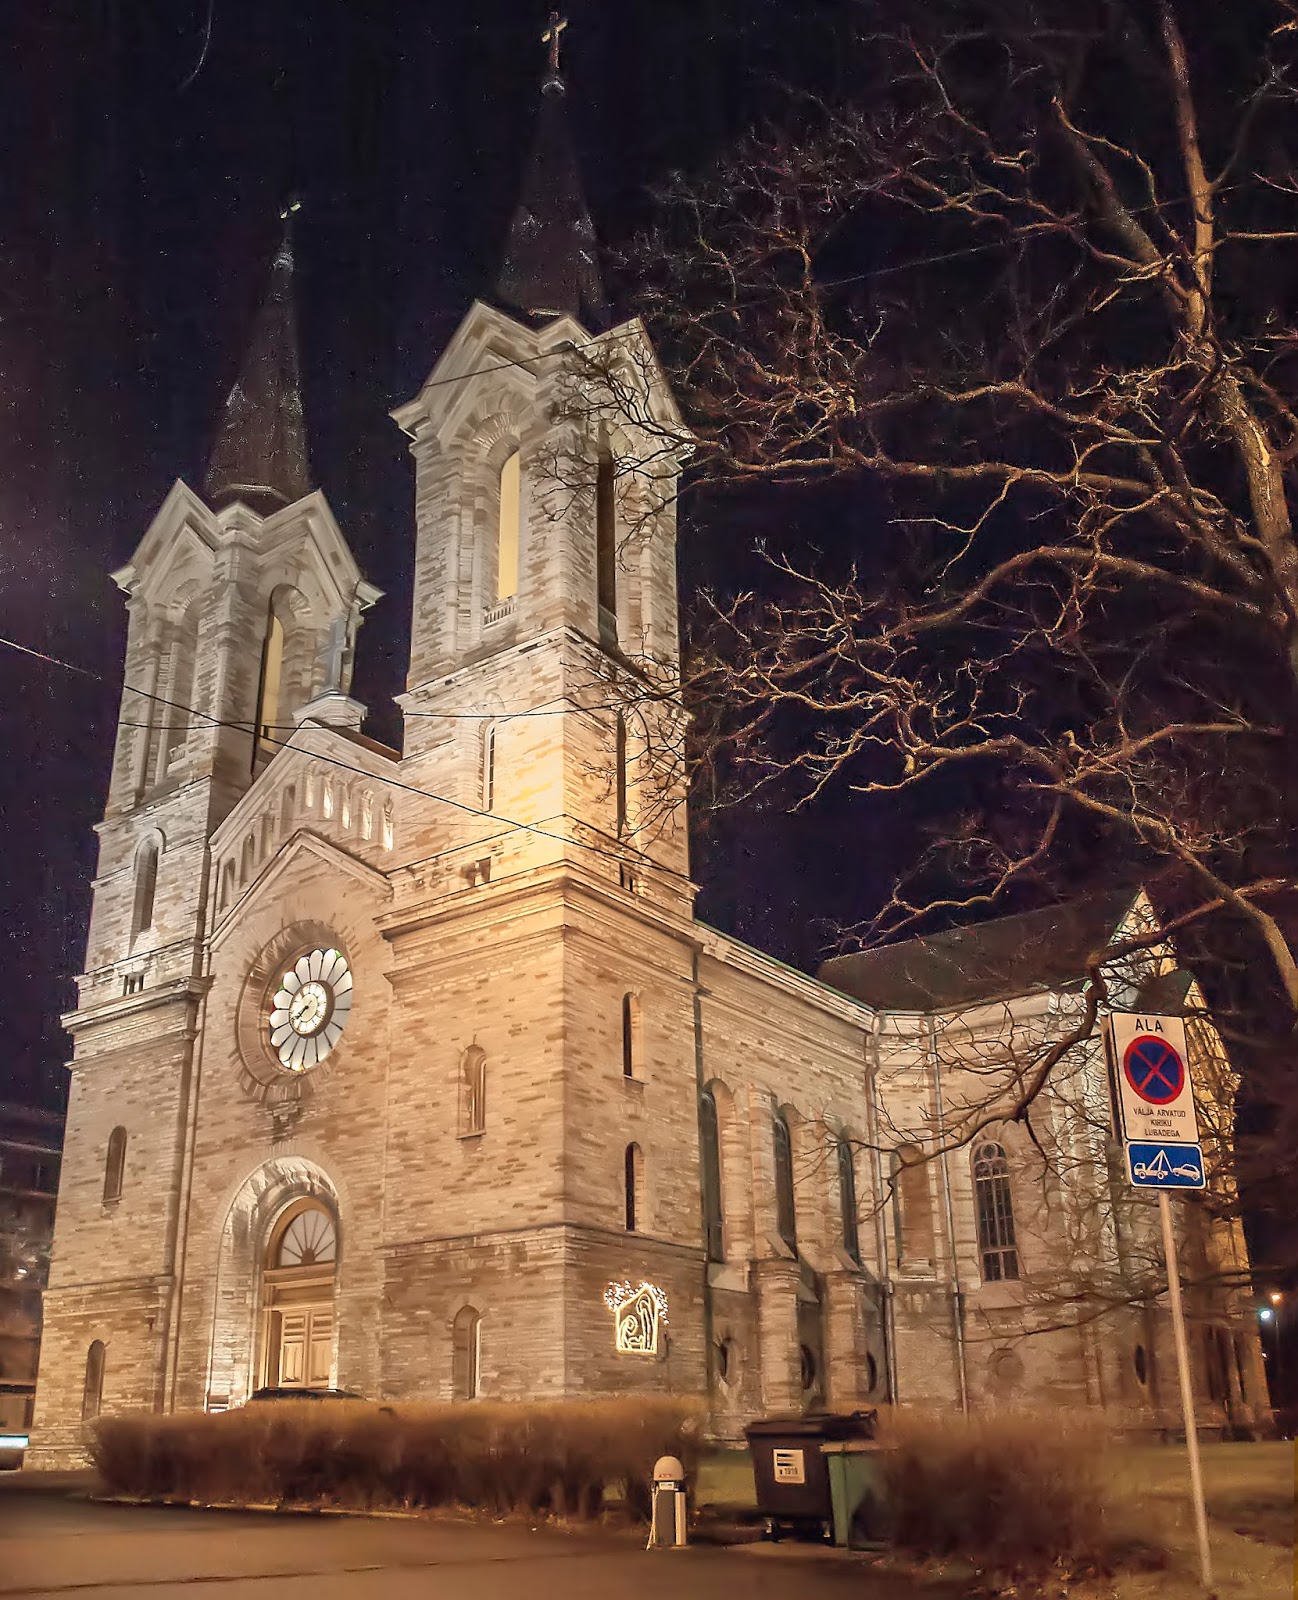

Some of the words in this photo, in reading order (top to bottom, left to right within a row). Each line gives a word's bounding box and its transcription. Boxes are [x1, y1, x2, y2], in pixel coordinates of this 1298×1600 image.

[1135, 1018, 1164, 1033] ALA
[1156, 1109, 1186, 1118] ARVATUD
[1151, 1119, 1172, 1127] KIRIKU
[1144, 1128, 1181, 1138] LUBADEGA
